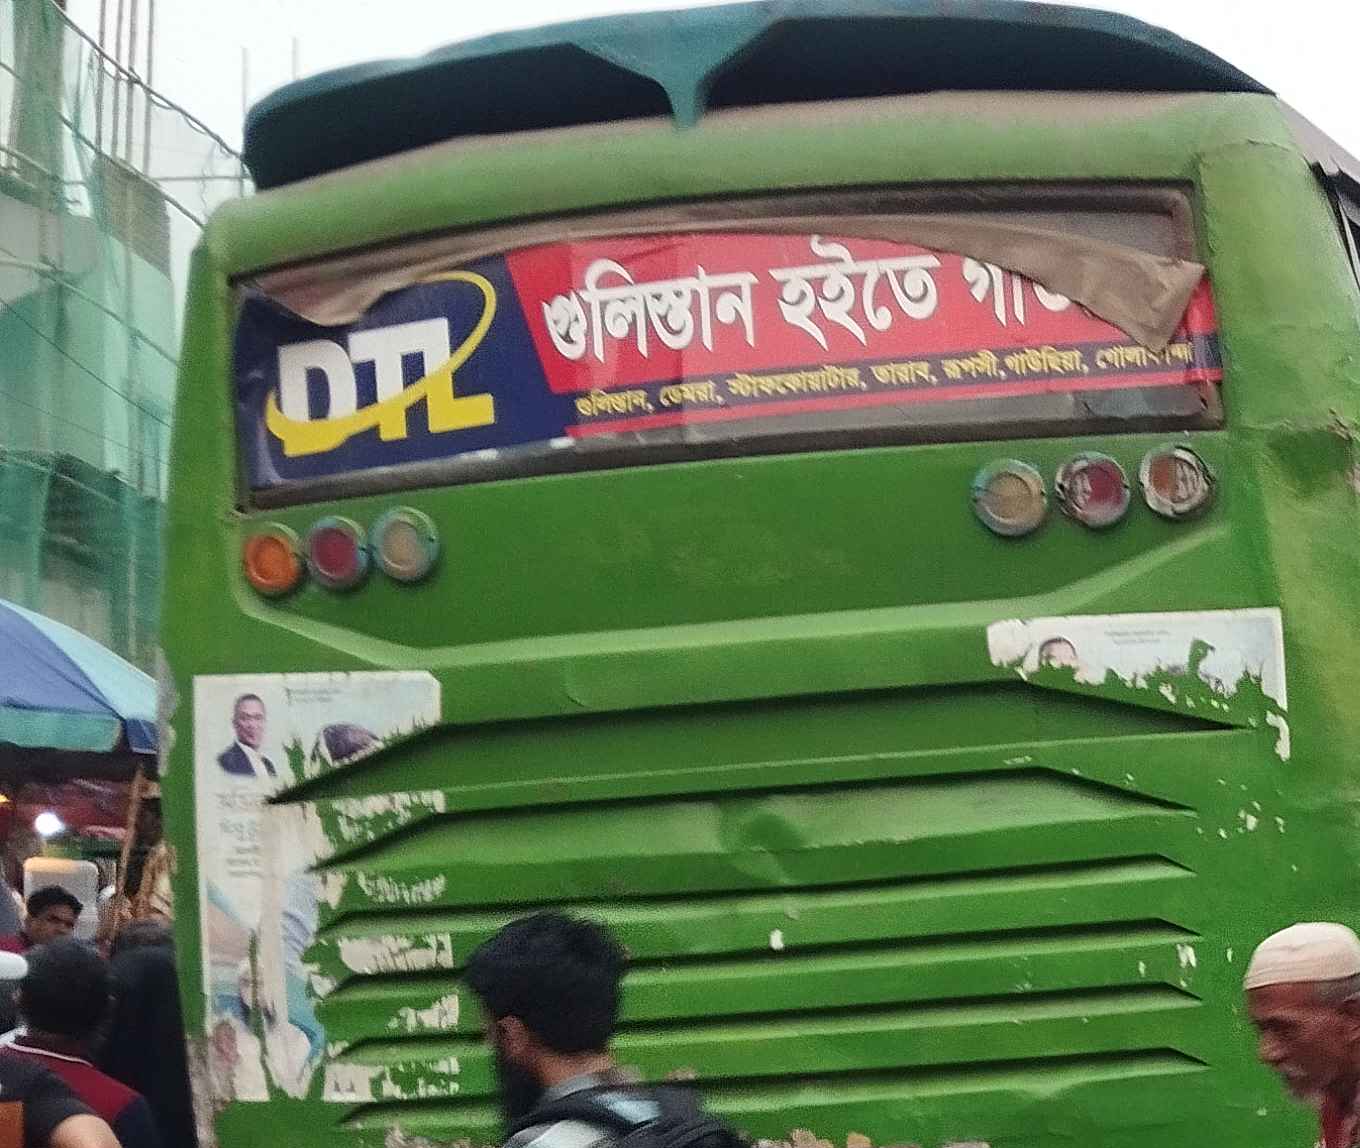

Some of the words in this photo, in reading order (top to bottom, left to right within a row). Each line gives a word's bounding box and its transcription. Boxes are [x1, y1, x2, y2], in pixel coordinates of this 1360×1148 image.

[541, 258, 759, 363] গুলিস্তান
[768, 235, 941, 351] হইতে
[275, 317, 496, 458] DTL
